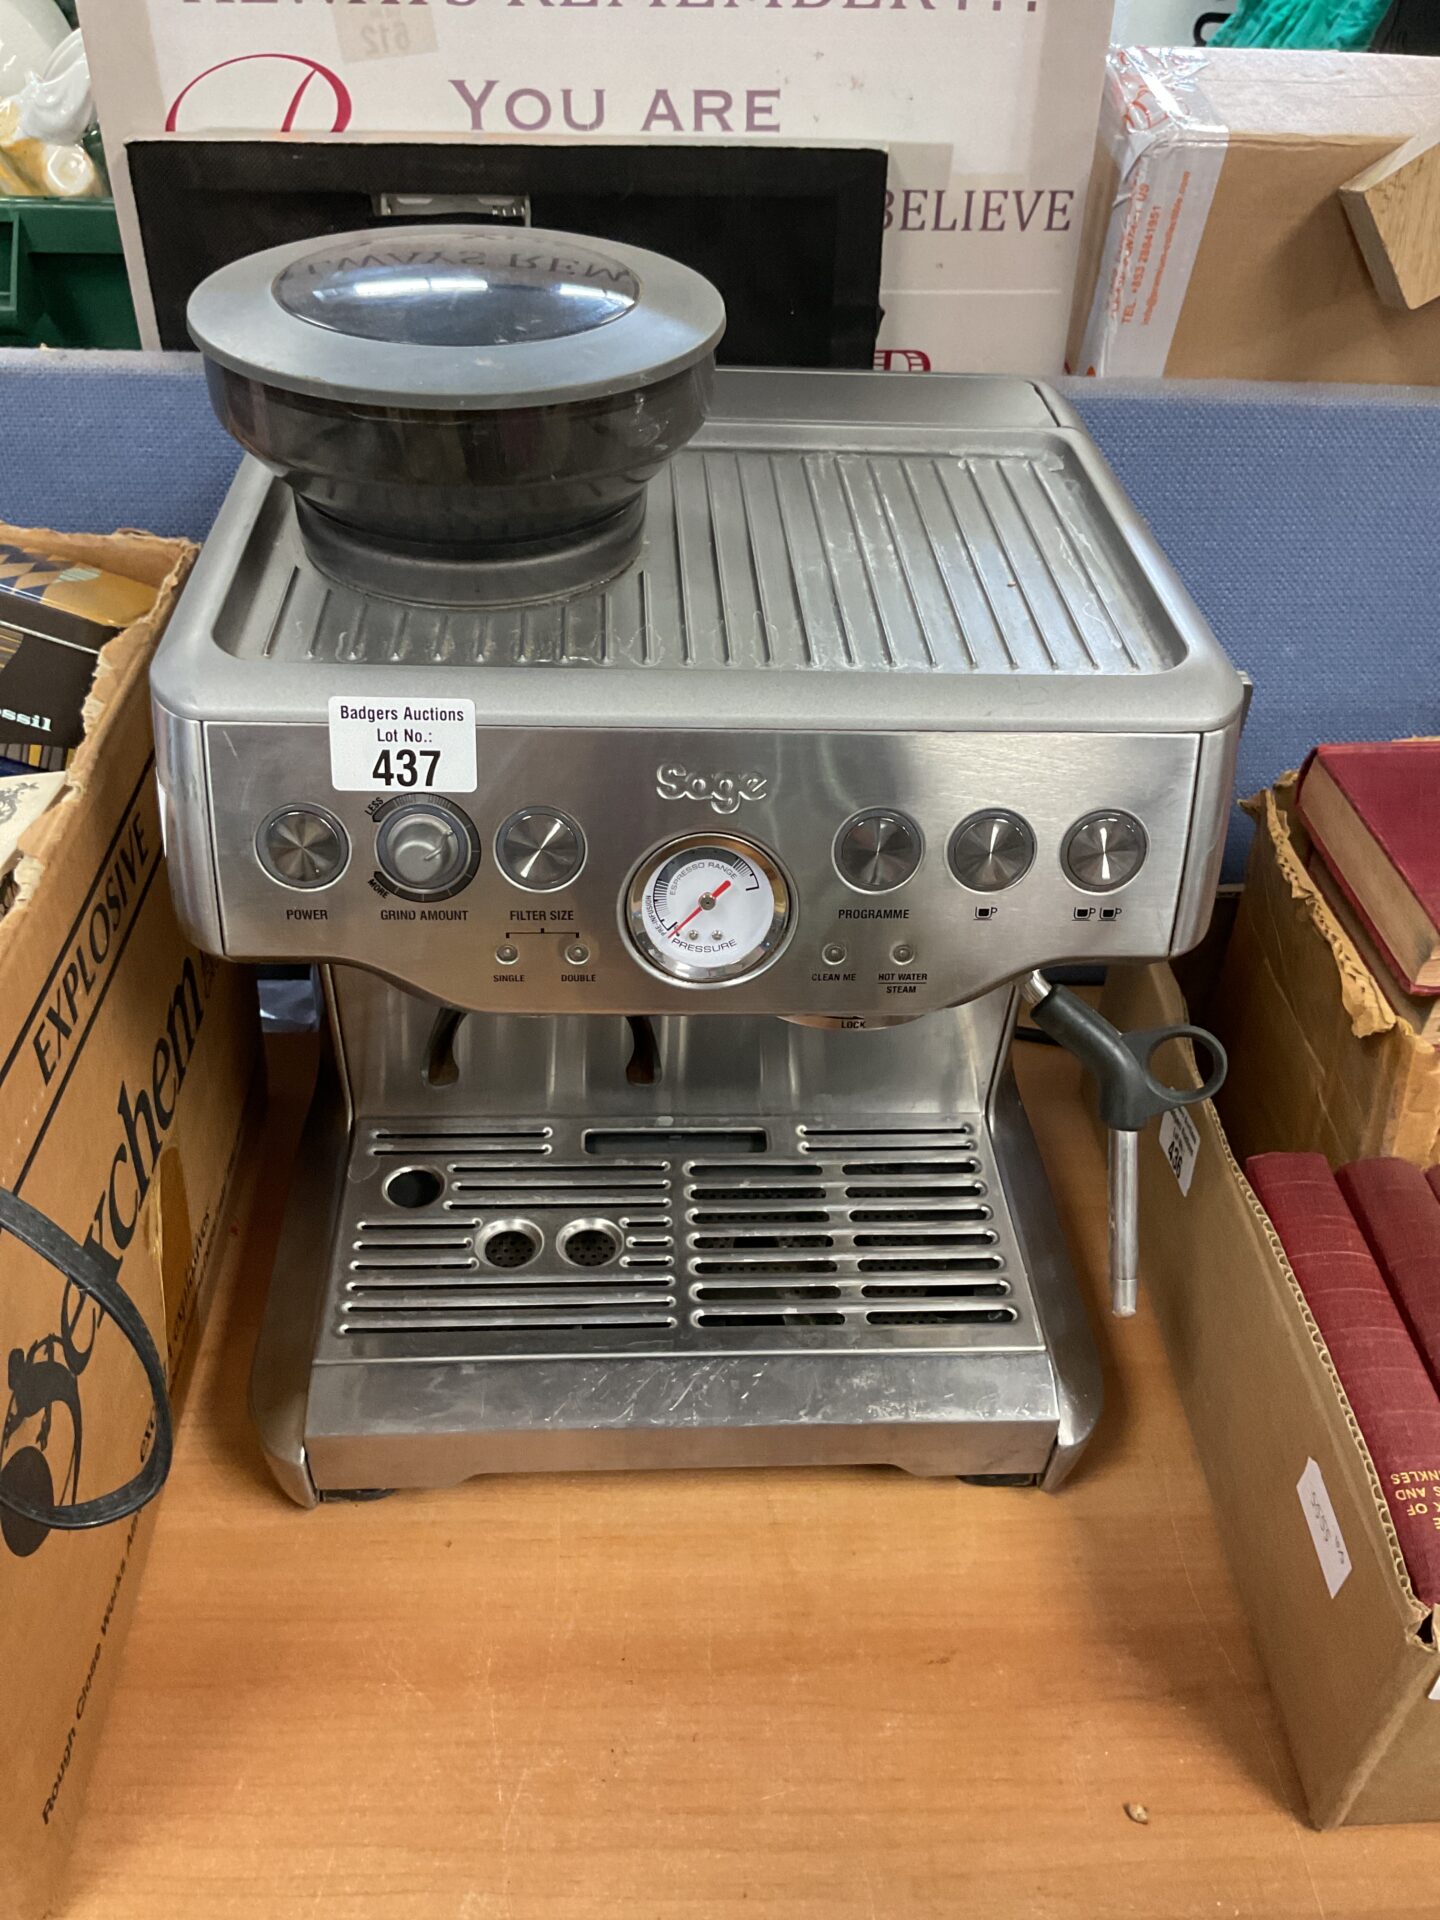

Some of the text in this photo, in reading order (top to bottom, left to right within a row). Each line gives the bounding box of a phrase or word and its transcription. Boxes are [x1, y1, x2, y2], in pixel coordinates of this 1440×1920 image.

[449, 79, 781, 133] YOU ARE
[0, 708, 52, 732] ssil
[340, 705, 465, 723] Badgers Auctions
[377, 728, 433, 743] Lot No.:
[372, 749, 441, 787] 437
[656, 762, 768, 815] Sage
[365, 797, 384, 816] LESS
[669, 862, 738, 896] ESPRESSO RANGE
[367, 878, 389, 899] MORE
[286, 909, 329, 921] POWER
[380, 909, 469, 921] GRIND AMOUNT
[509, 910, 574, 921] FILTER SIZE
[838, 909, 910, 919] PROGRAMME
[32, 811, 150, 1087] EXPLOSIVE
[671, 938, 738, 953] PRESSURE
[493, 974, 526, 983] SINGLE
[561, 974, 597, 983] DOUBLE
[811, 973, 857, 981] CLEAN ME
[878, 973, 928, 981] HOT WATER
[886, 986, 917, 994] STEAM
[841, 1020, 866, 1029] LOCK
[1390, 1470, 1440, 1485] NKLES
[1395, 1487, 1426, 1501] AND
[1406, 1503, 1428, 1516] OF
[42, 1727, 77, 1825] Rough
